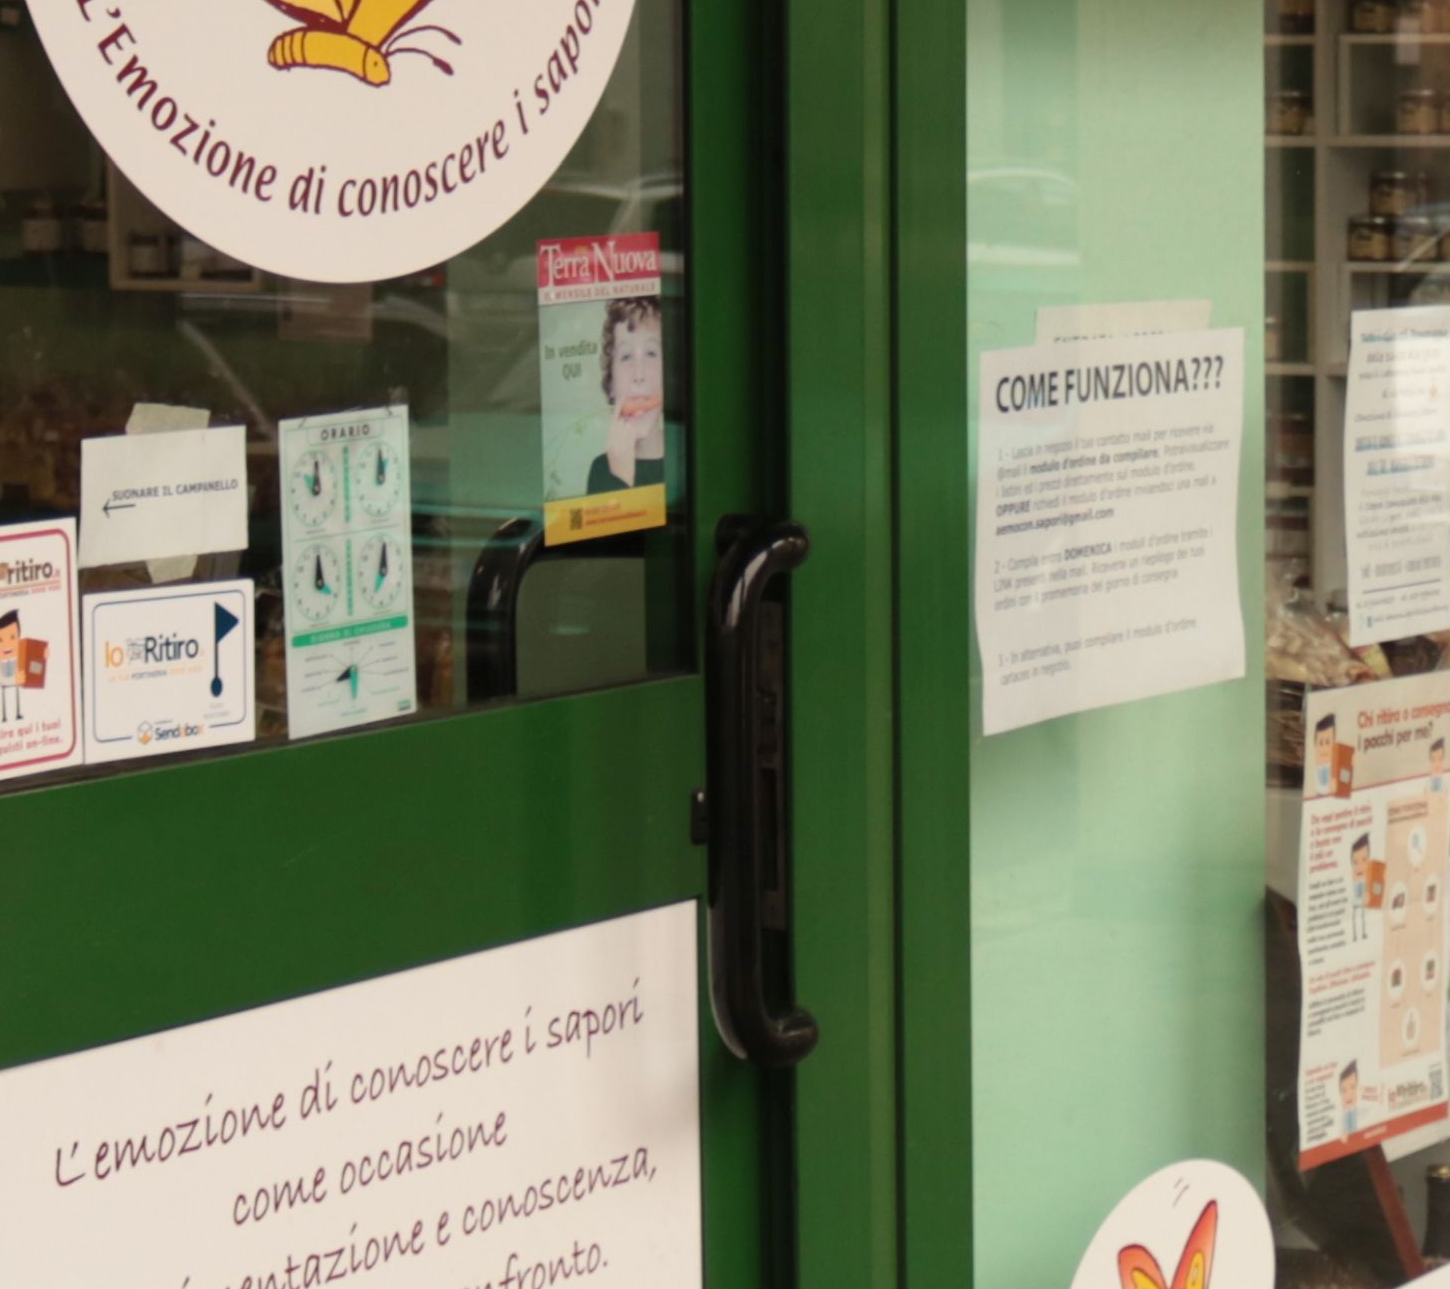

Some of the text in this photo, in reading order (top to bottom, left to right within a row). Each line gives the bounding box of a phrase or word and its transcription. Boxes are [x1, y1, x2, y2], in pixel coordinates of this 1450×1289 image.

[289, 164, 326, 217] di
[336, 120, 509, 217] conoscere
[513, 88, 529, 137] i
[539, 240, 657, 286] Terra Nuova
[558, 342, 598, 358] vendita
[562, 363, 581, 380] QUI
[996, 356, 1224, 412] COME FUNZIONA???
[321, 424, 370, 441] ORARIO
[111, 479, 238, 501] SUONARE IL CAMPANELLO
[54, 977, 644, 1187] L'emozione di conoscere i sapori
[233, 1110, 508, 1225] come occasione
[437, 1211, 451, 1246] e
[462, 1143, 658, 1236] conoscenza,
